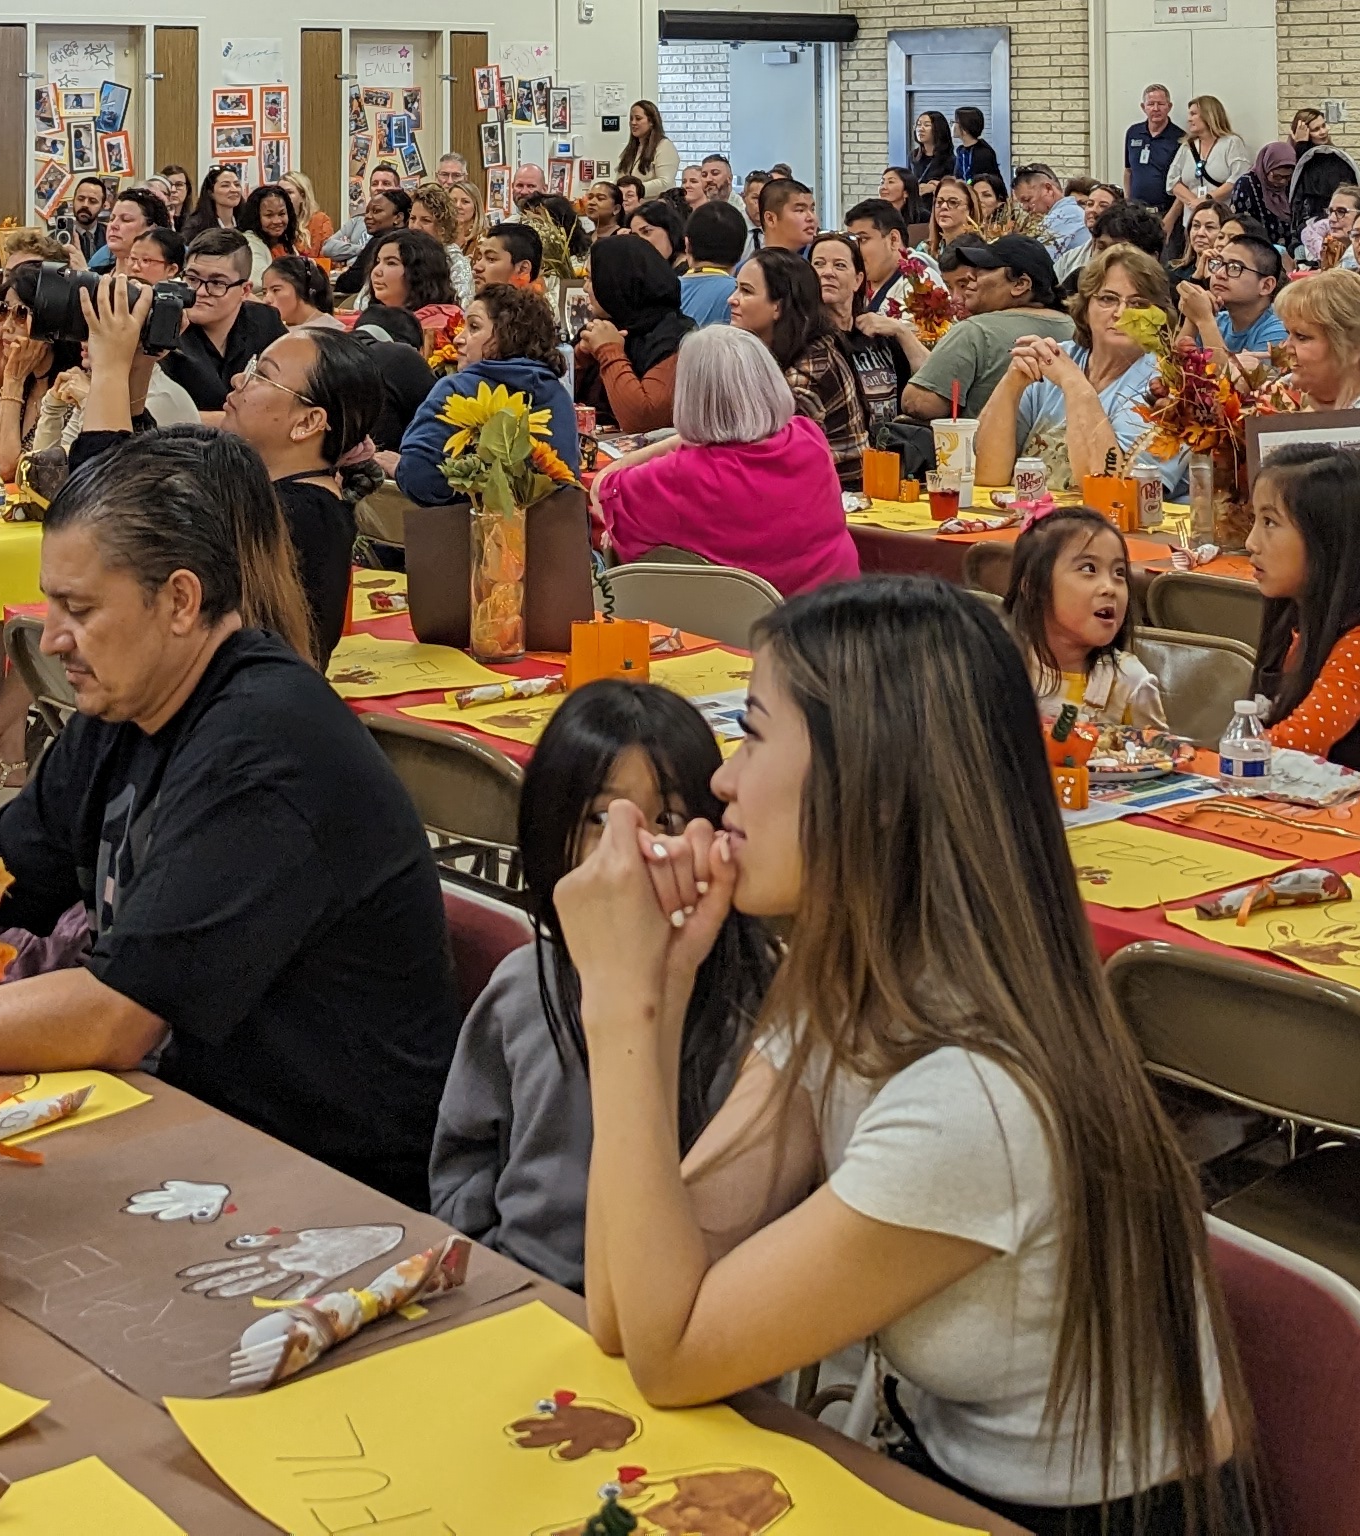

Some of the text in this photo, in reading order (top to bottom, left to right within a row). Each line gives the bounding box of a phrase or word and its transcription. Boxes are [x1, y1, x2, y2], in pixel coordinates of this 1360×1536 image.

[1168, 6, 1178, 14] NO
[368, 45, 392, 56] CHEF
[364, 62, 411, 77] EMILY!
[603, 118, 618, 126] EXIT
